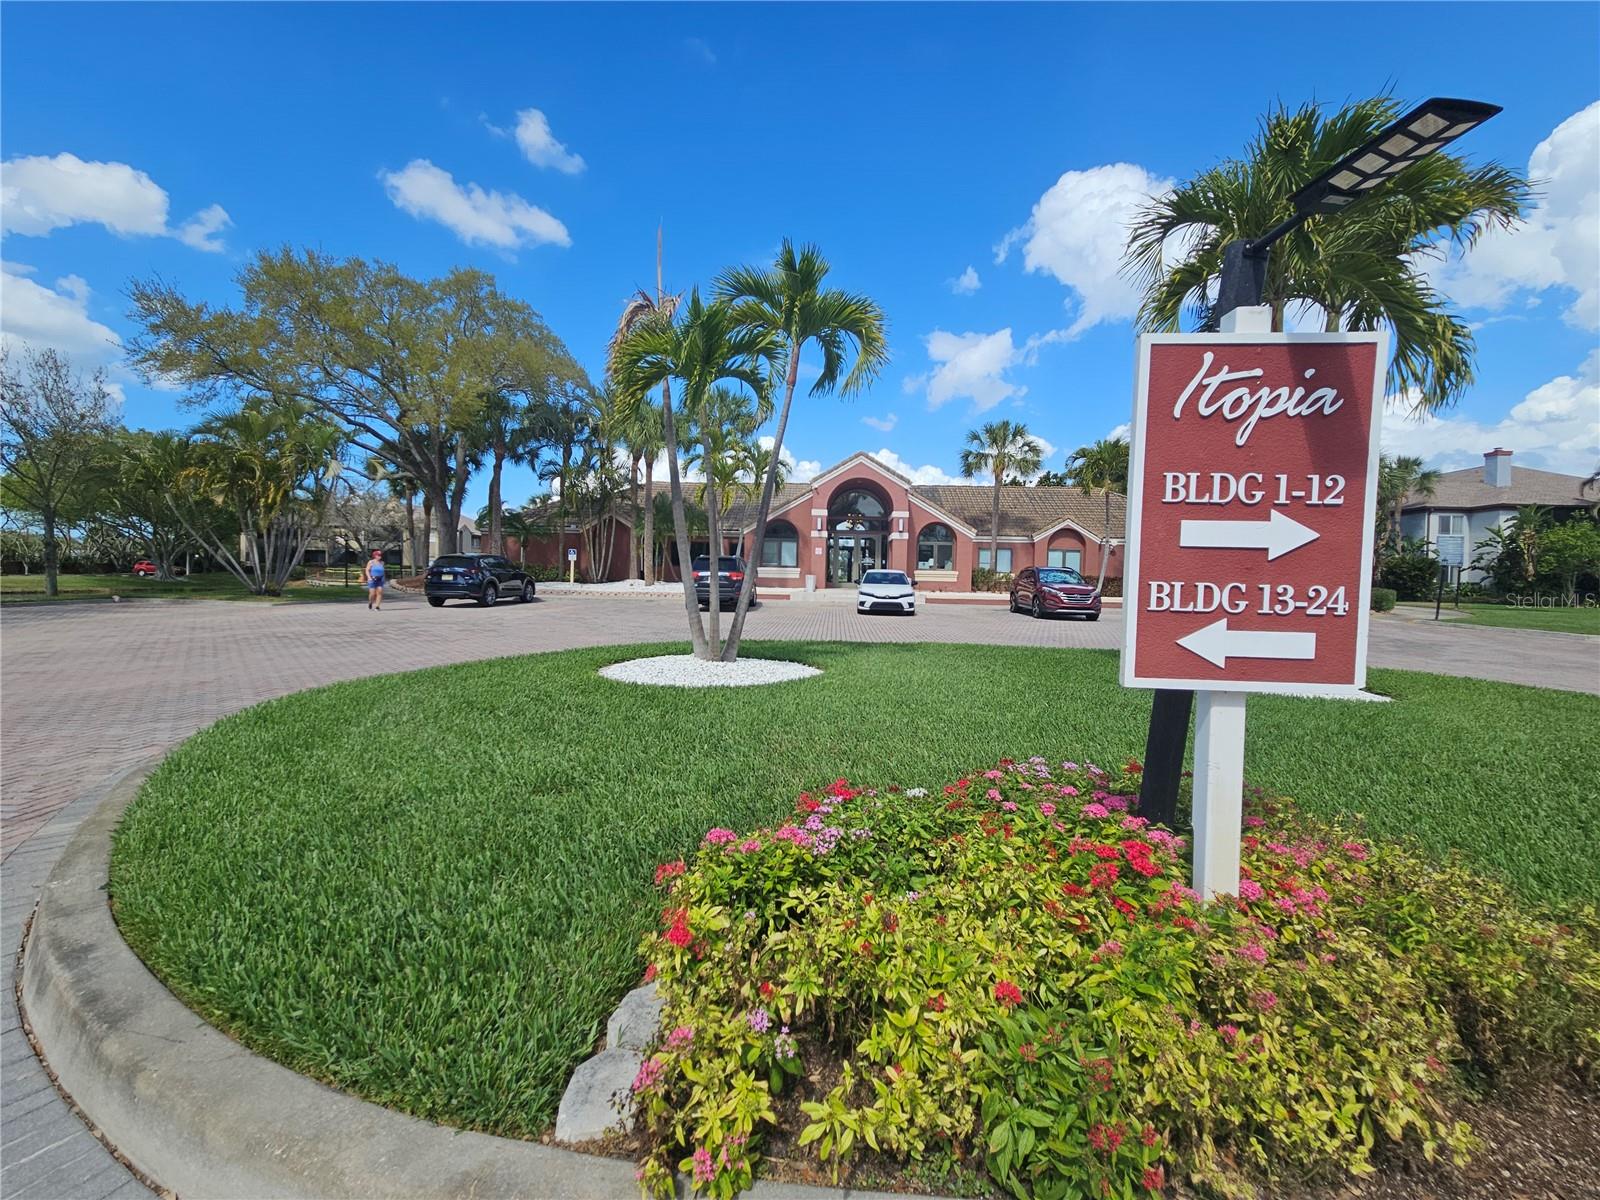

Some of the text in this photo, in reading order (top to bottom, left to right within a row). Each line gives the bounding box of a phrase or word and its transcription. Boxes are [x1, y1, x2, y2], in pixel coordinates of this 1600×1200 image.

[1173, 351, 1344, 446] Itopia
[1162, 472, 1346, 505] BLDG 1-12
[1147, 581, 1349, 616] BLDG 13-24
